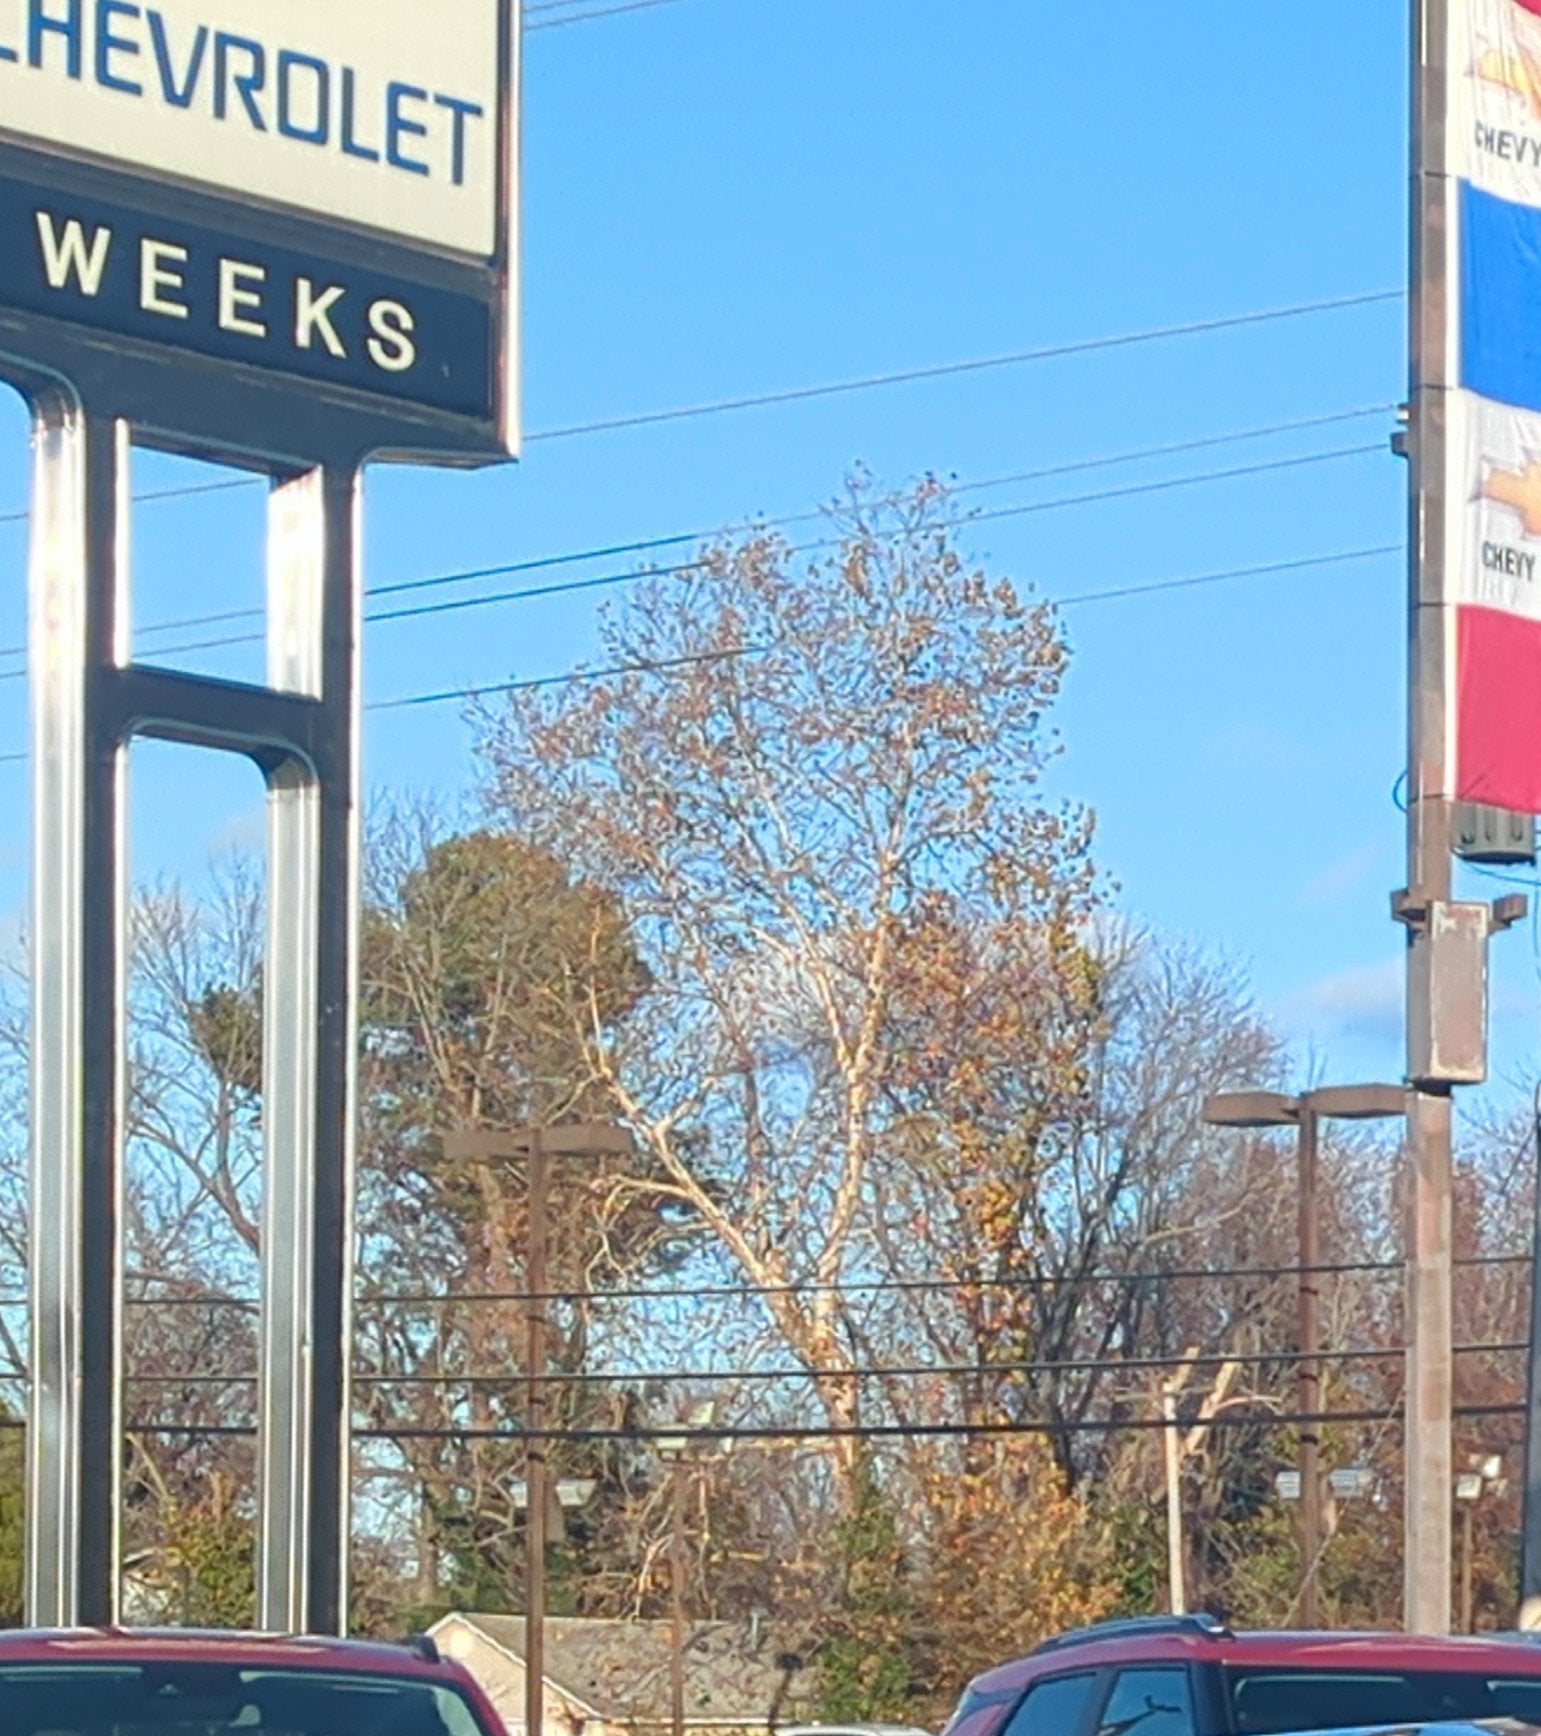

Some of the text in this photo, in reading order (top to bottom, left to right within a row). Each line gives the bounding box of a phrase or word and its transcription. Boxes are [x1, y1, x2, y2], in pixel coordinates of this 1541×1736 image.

[0, 0, 484, 186] HEVROLET
[36, 210, 417, 372] WEEKS
[1482, 540, 1535, 582] CHEVY
